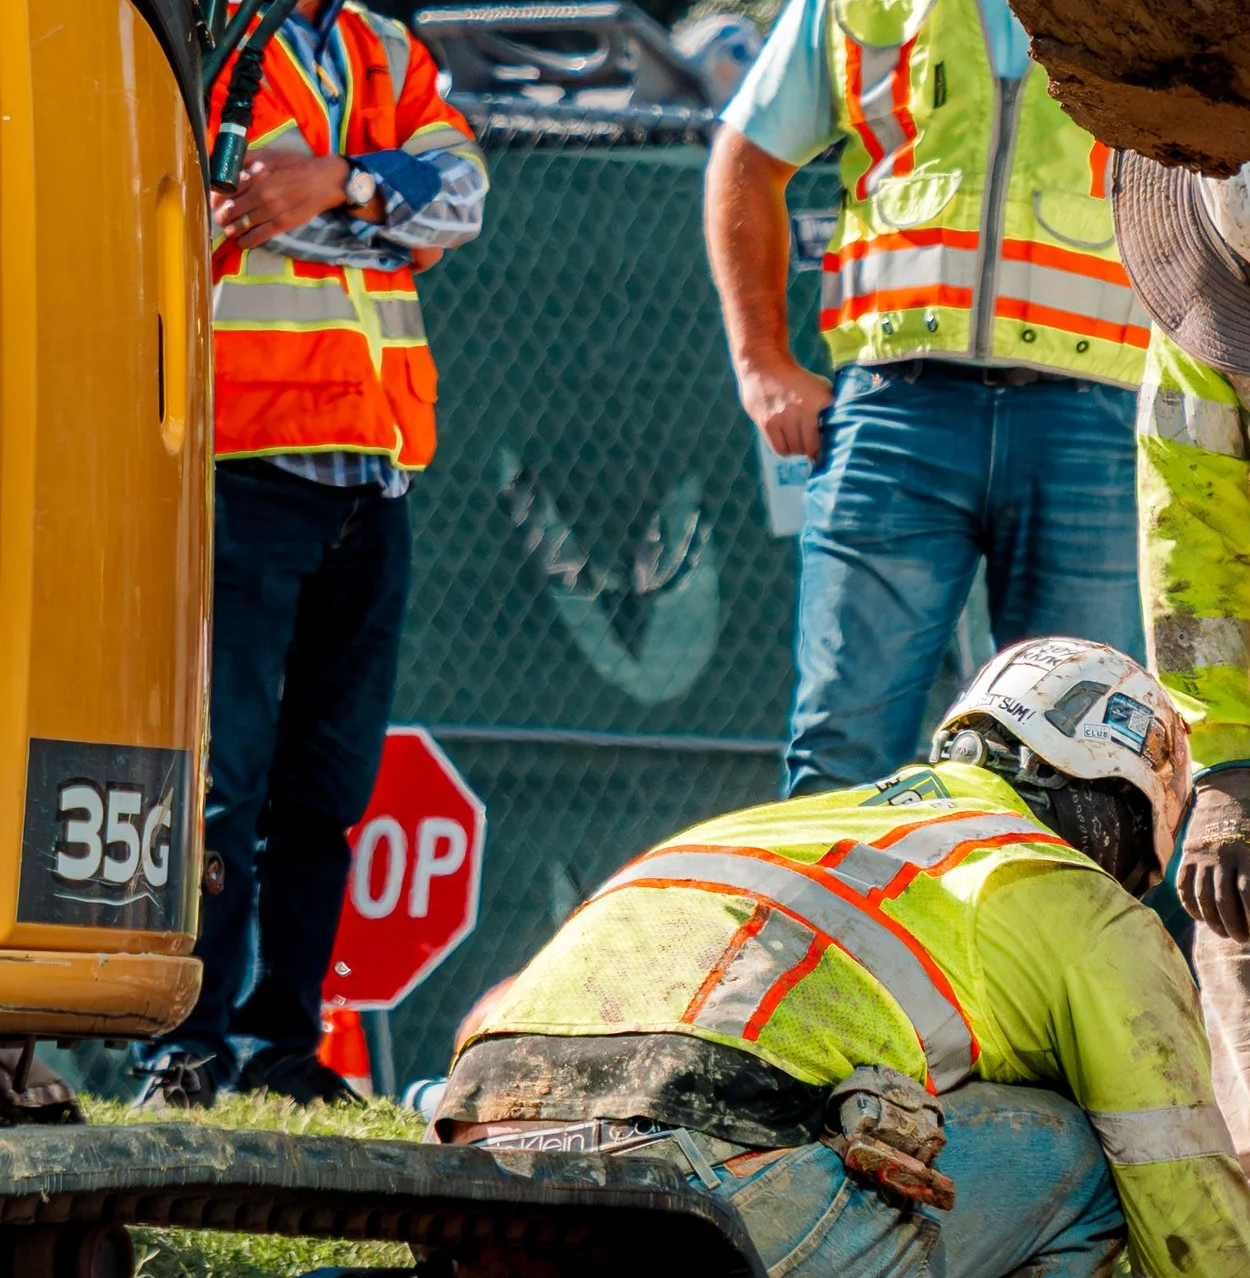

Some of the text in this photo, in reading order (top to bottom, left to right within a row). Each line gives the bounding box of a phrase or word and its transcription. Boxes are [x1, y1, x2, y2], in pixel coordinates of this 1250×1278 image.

[999, 696, 1036, 725] SUM!
[56, 785, 173, 887] 35G
[351, 814, 468, 919] OP
[521, 1133, 585, 1152] Klein
